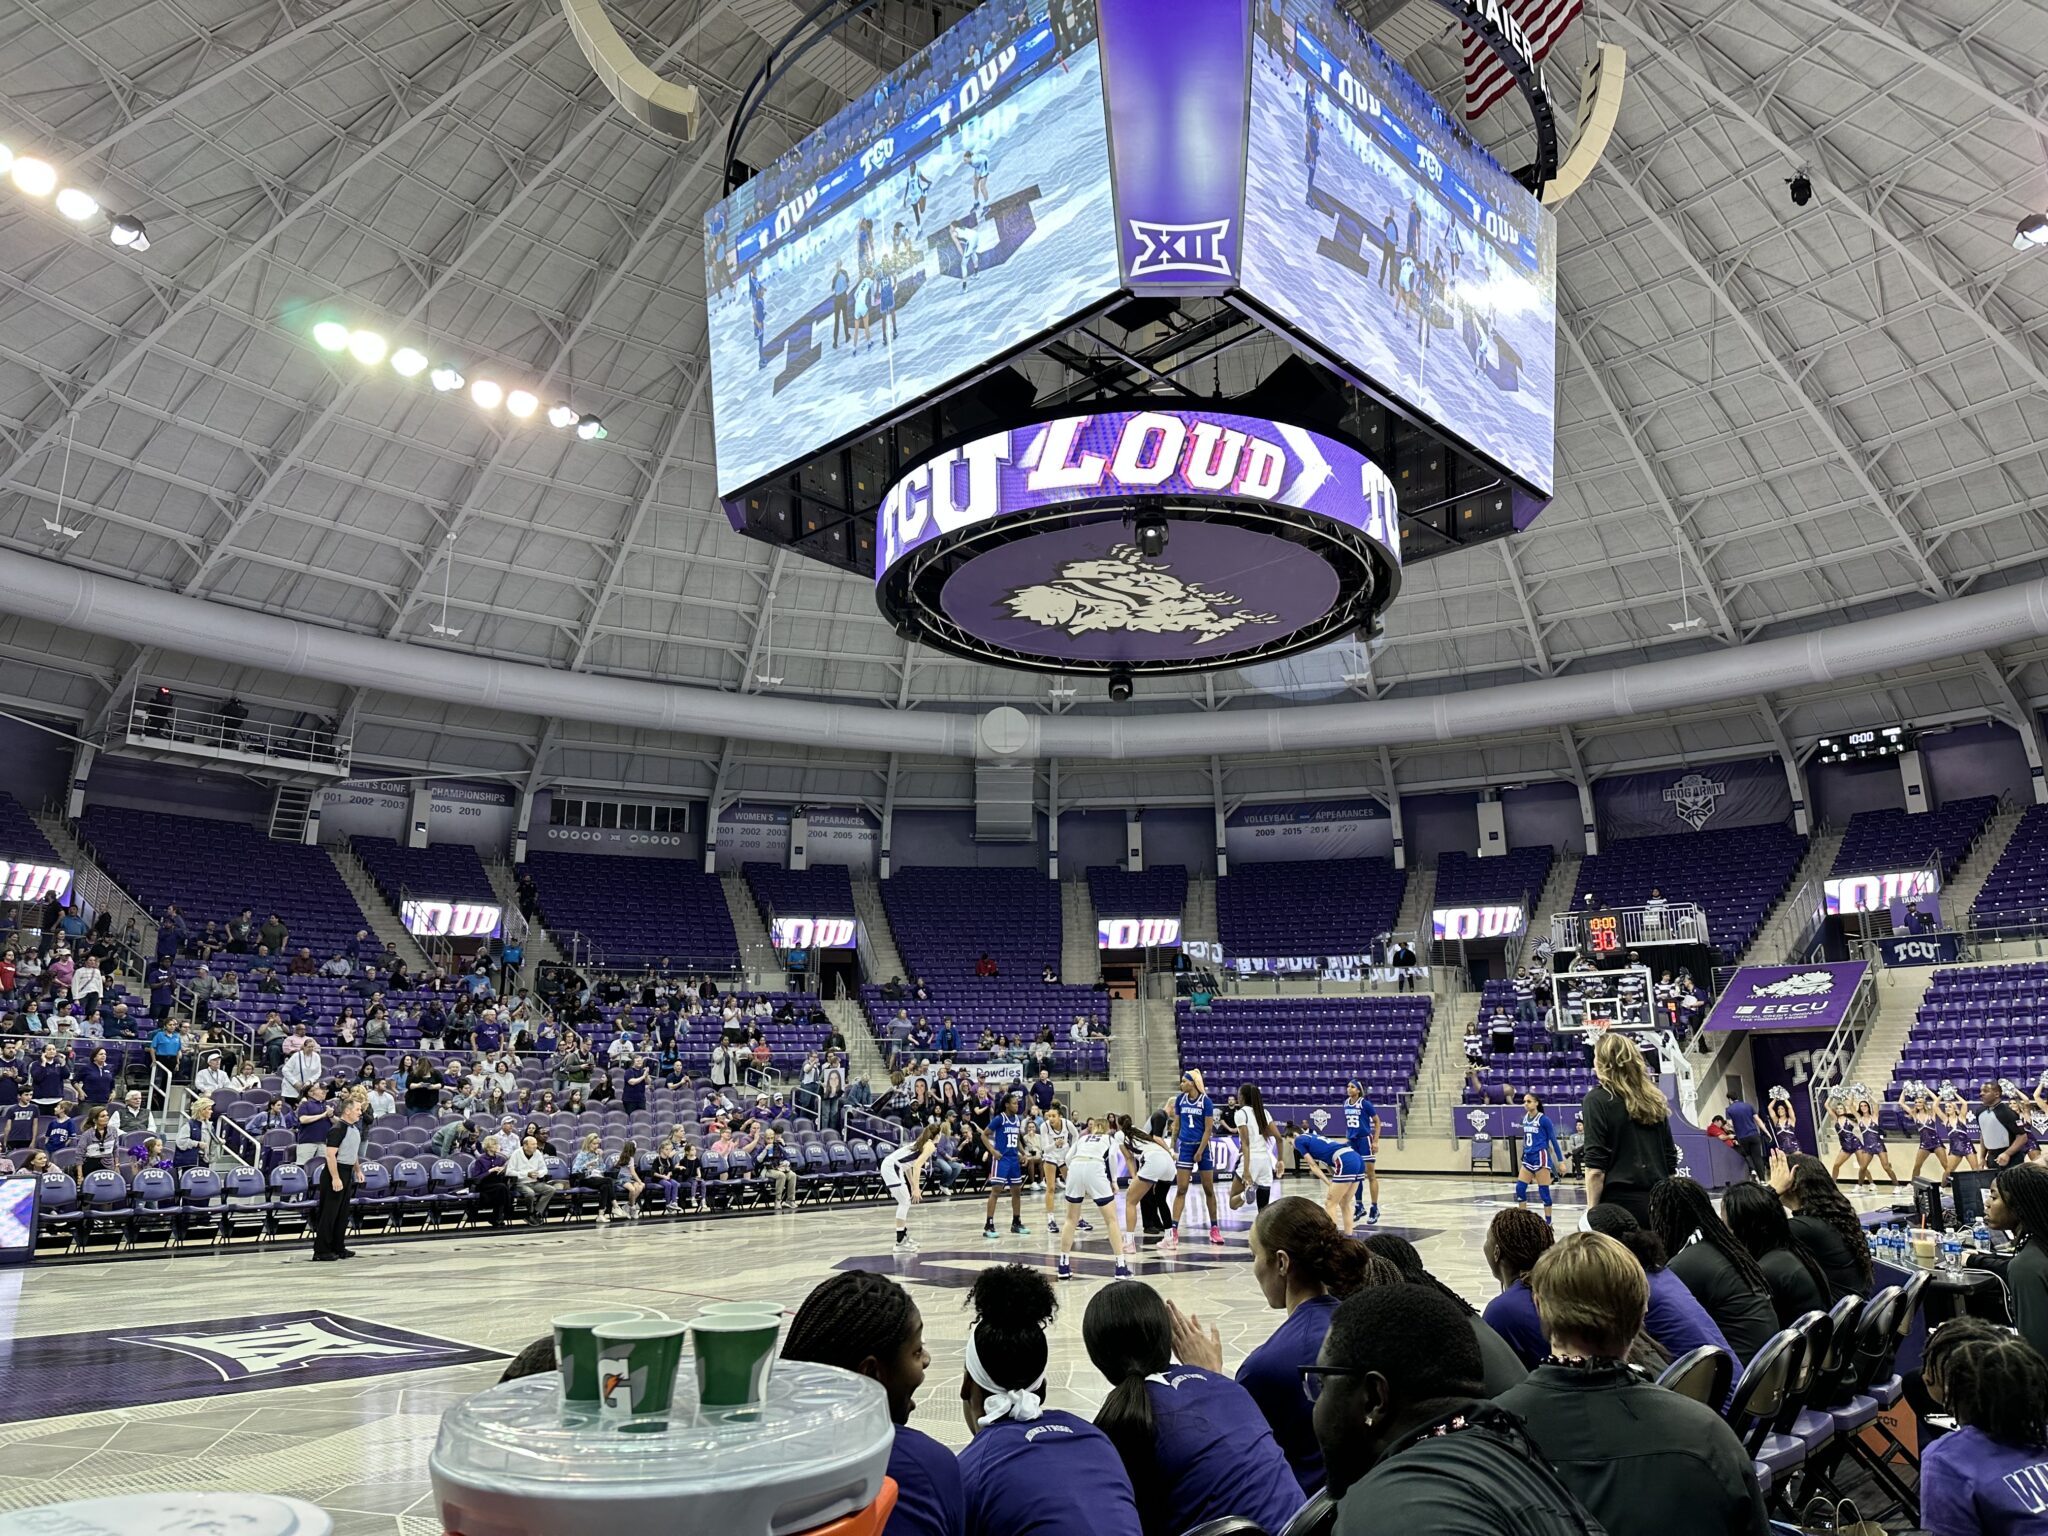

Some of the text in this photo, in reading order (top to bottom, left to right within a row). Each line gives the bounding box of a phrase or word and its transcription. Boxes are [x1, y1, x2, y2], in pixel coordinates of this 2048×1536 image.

[882, 429, 1013, 566] TCU
[1027, 411, 1287, 501] LOUD
[1849, 731, 1874, 744] 10:00
[431, 787, 506, 802] CHAMPIONSHIPS
[1664, 783, 1723, 800] FROG ARMY
[349, 795, 374, 806] 2002
[380, 800, 405, 810] 2003
[459, 807, 481, 817] 2010
[734, 812, 774, 822] WOMEN'S
[808, 815, 865, 826] APPEARANCES
[1243, 814, 1296, 824] VOLLEYBALL
[1315, 808, 1375, 821] APPEARANCES
[740, 828, 761, 836] 2002
[766, 828, 787, 837] 2003
[808, 830, 828, 838] 2004
[832, 831, 853, 840] 2005
[1255, 829, 1276, 837] 2009
[1282, 827, 1303, 836] 2015
[739, 840, 761, 849] 2009
[766, 841, 786, 849] 2010
[1589, 916, 1617, 930] 10:00
[1107, 918, 1180, 949] OUD
[1591, 930, 1616, 951] 30
[1893, 941, 1936, 962] TCU
[1761, 1000, 1829, 1014] EECU
[1187, 1115, 1195, 1128] 1
[1006, 1134, 1018, 1148] 15
[1526, 1133, 1533, 1147] 0
[734, 1149, 747, 1157] TCU
[809, 1145, 822, 1153] TCU
[834, 1144, 846, 1152] TCU
[706, 1151, 719, 1159] TCU
[278, 1165, 298, 1175] TCU
[362, 1164, 380, 1172] TCU
[400, 1161, 418, 1170] TCU
[438, 1160, 455, 1169] TCU
[93, 1171, 115, 1182] TCU
[143, 1169, 164, 1180] TCU
[189, 1168, 211, 1179] TCU
[235, 1166, 256, 1176] TCU
[43, 1172, 66, 1184] TCU
